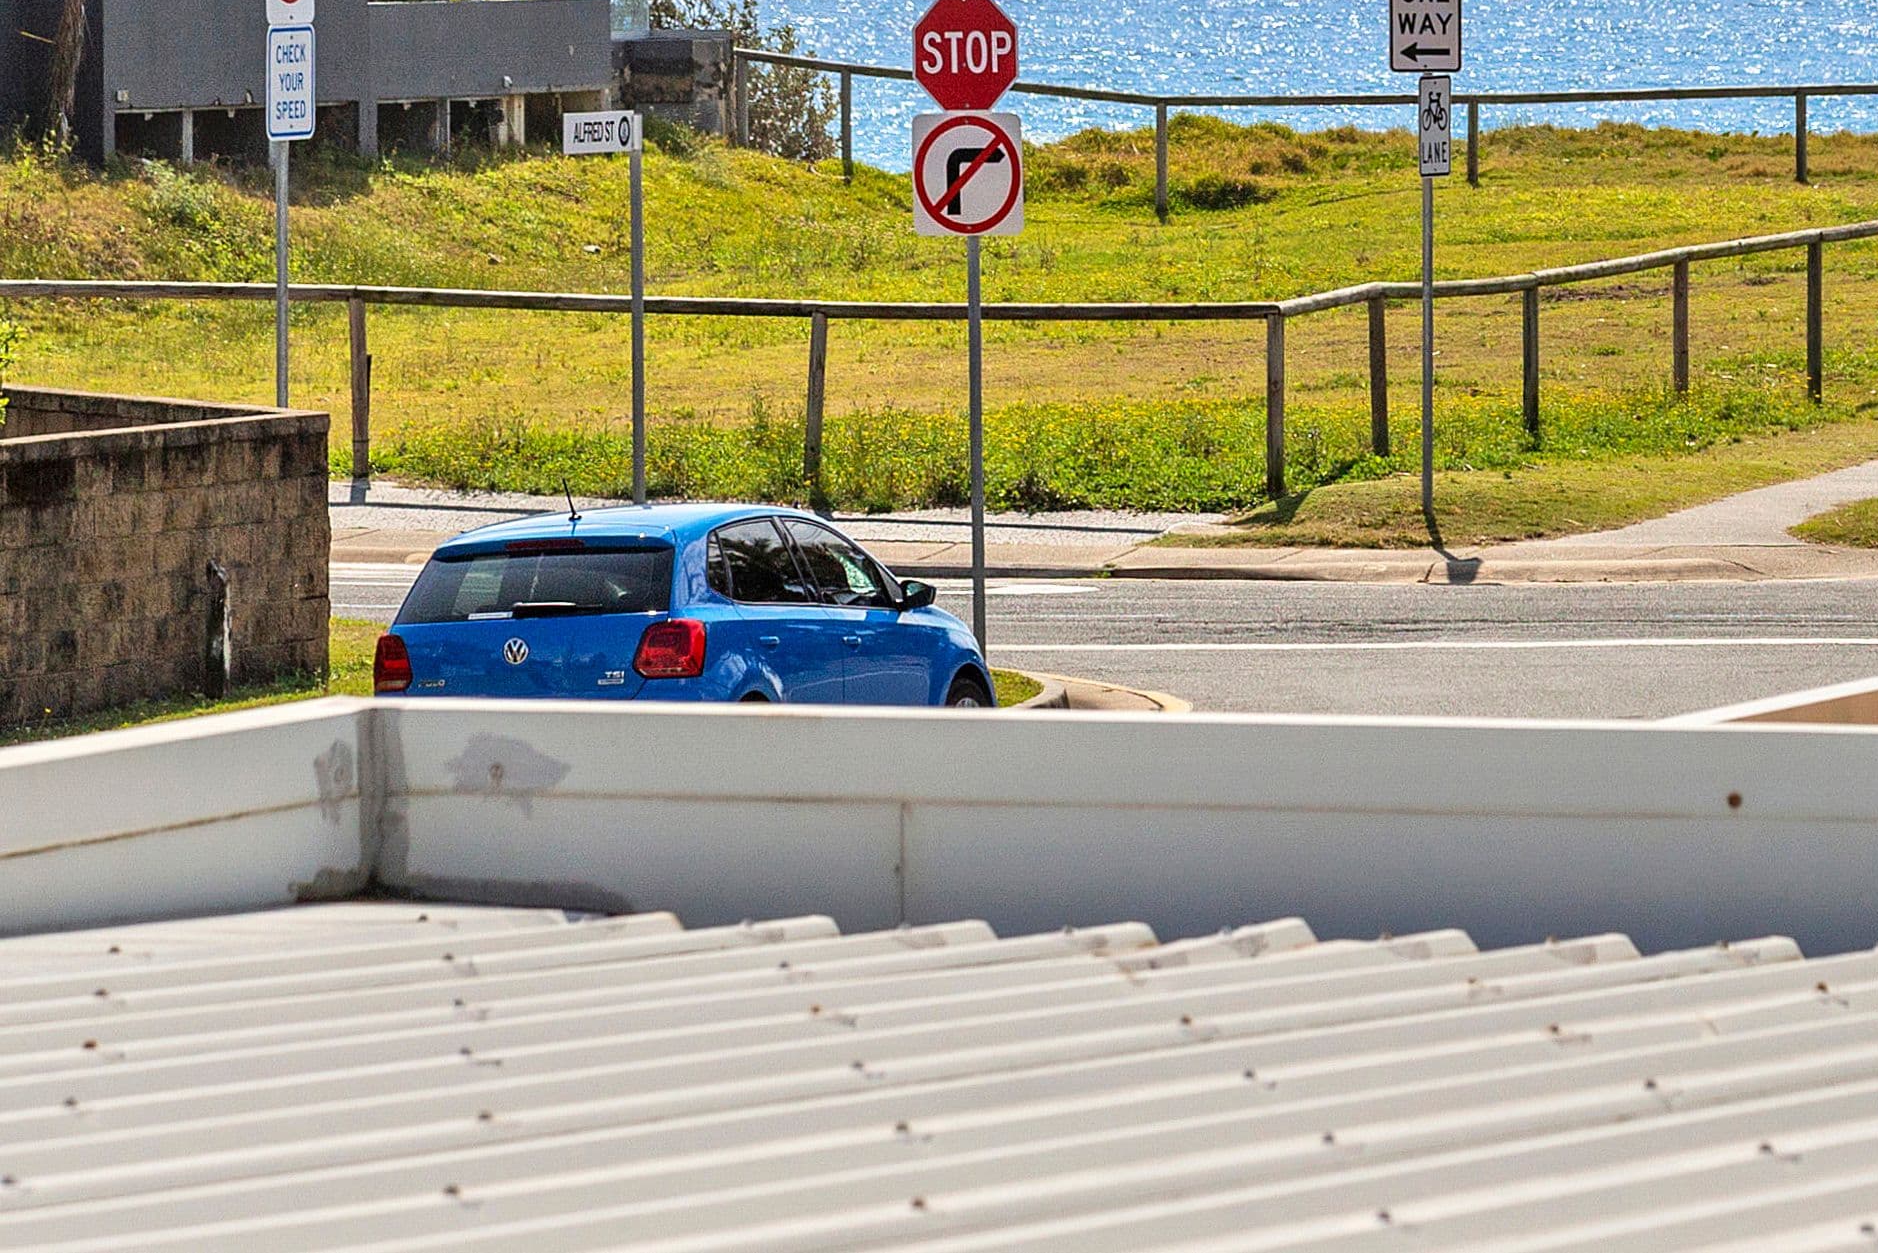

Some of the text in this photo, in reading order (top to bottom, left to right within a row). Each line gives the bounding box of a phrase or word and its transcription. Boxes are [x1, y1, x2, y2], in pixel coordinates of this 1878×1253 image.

[1398, 13, 1453, 35] WAY
[276, 44, 306, 64] CHECK
[922, 30, 1012, 74] STOP
[278, 72, 304, 93] YOUR
[276, 100, 306, 121] SPEED
[573, 121, 615, 143] ALFRED ST
[1422, 141, 1447, 164] LANE
